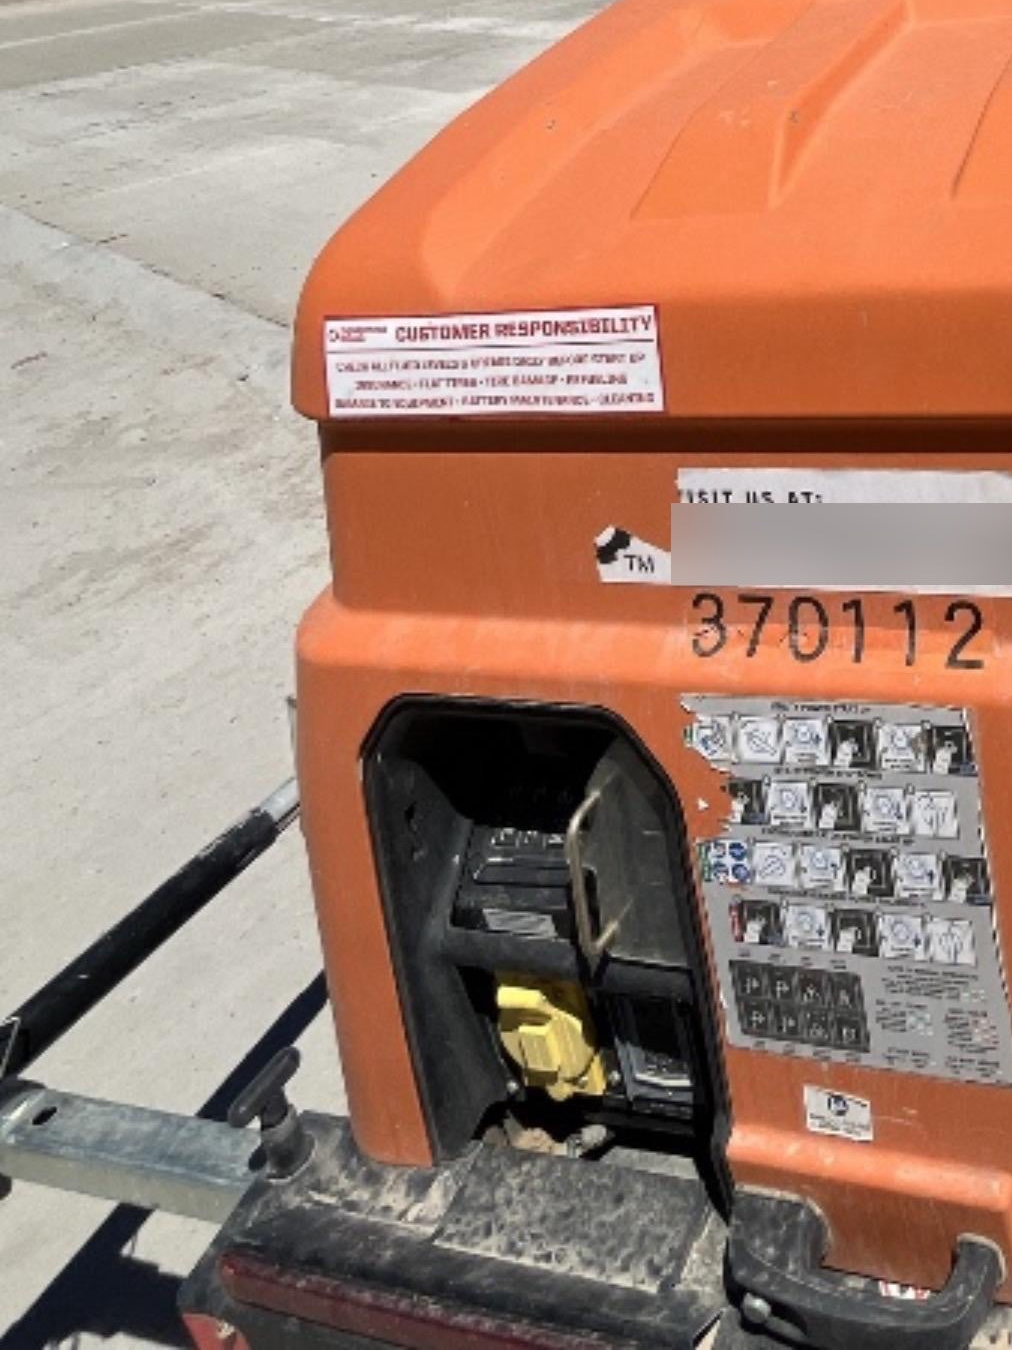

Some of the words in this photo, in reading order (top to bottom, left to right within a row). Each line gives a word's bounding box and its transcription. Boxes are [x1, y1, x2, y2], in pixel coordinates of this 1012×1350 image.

[395, 324, 490, 343] CUSTOMER
[495, 315, 652, 337] RESPONSIBILITY
[623, 554, 655, 574] TM
[691, 593, 985, 669] 370112
